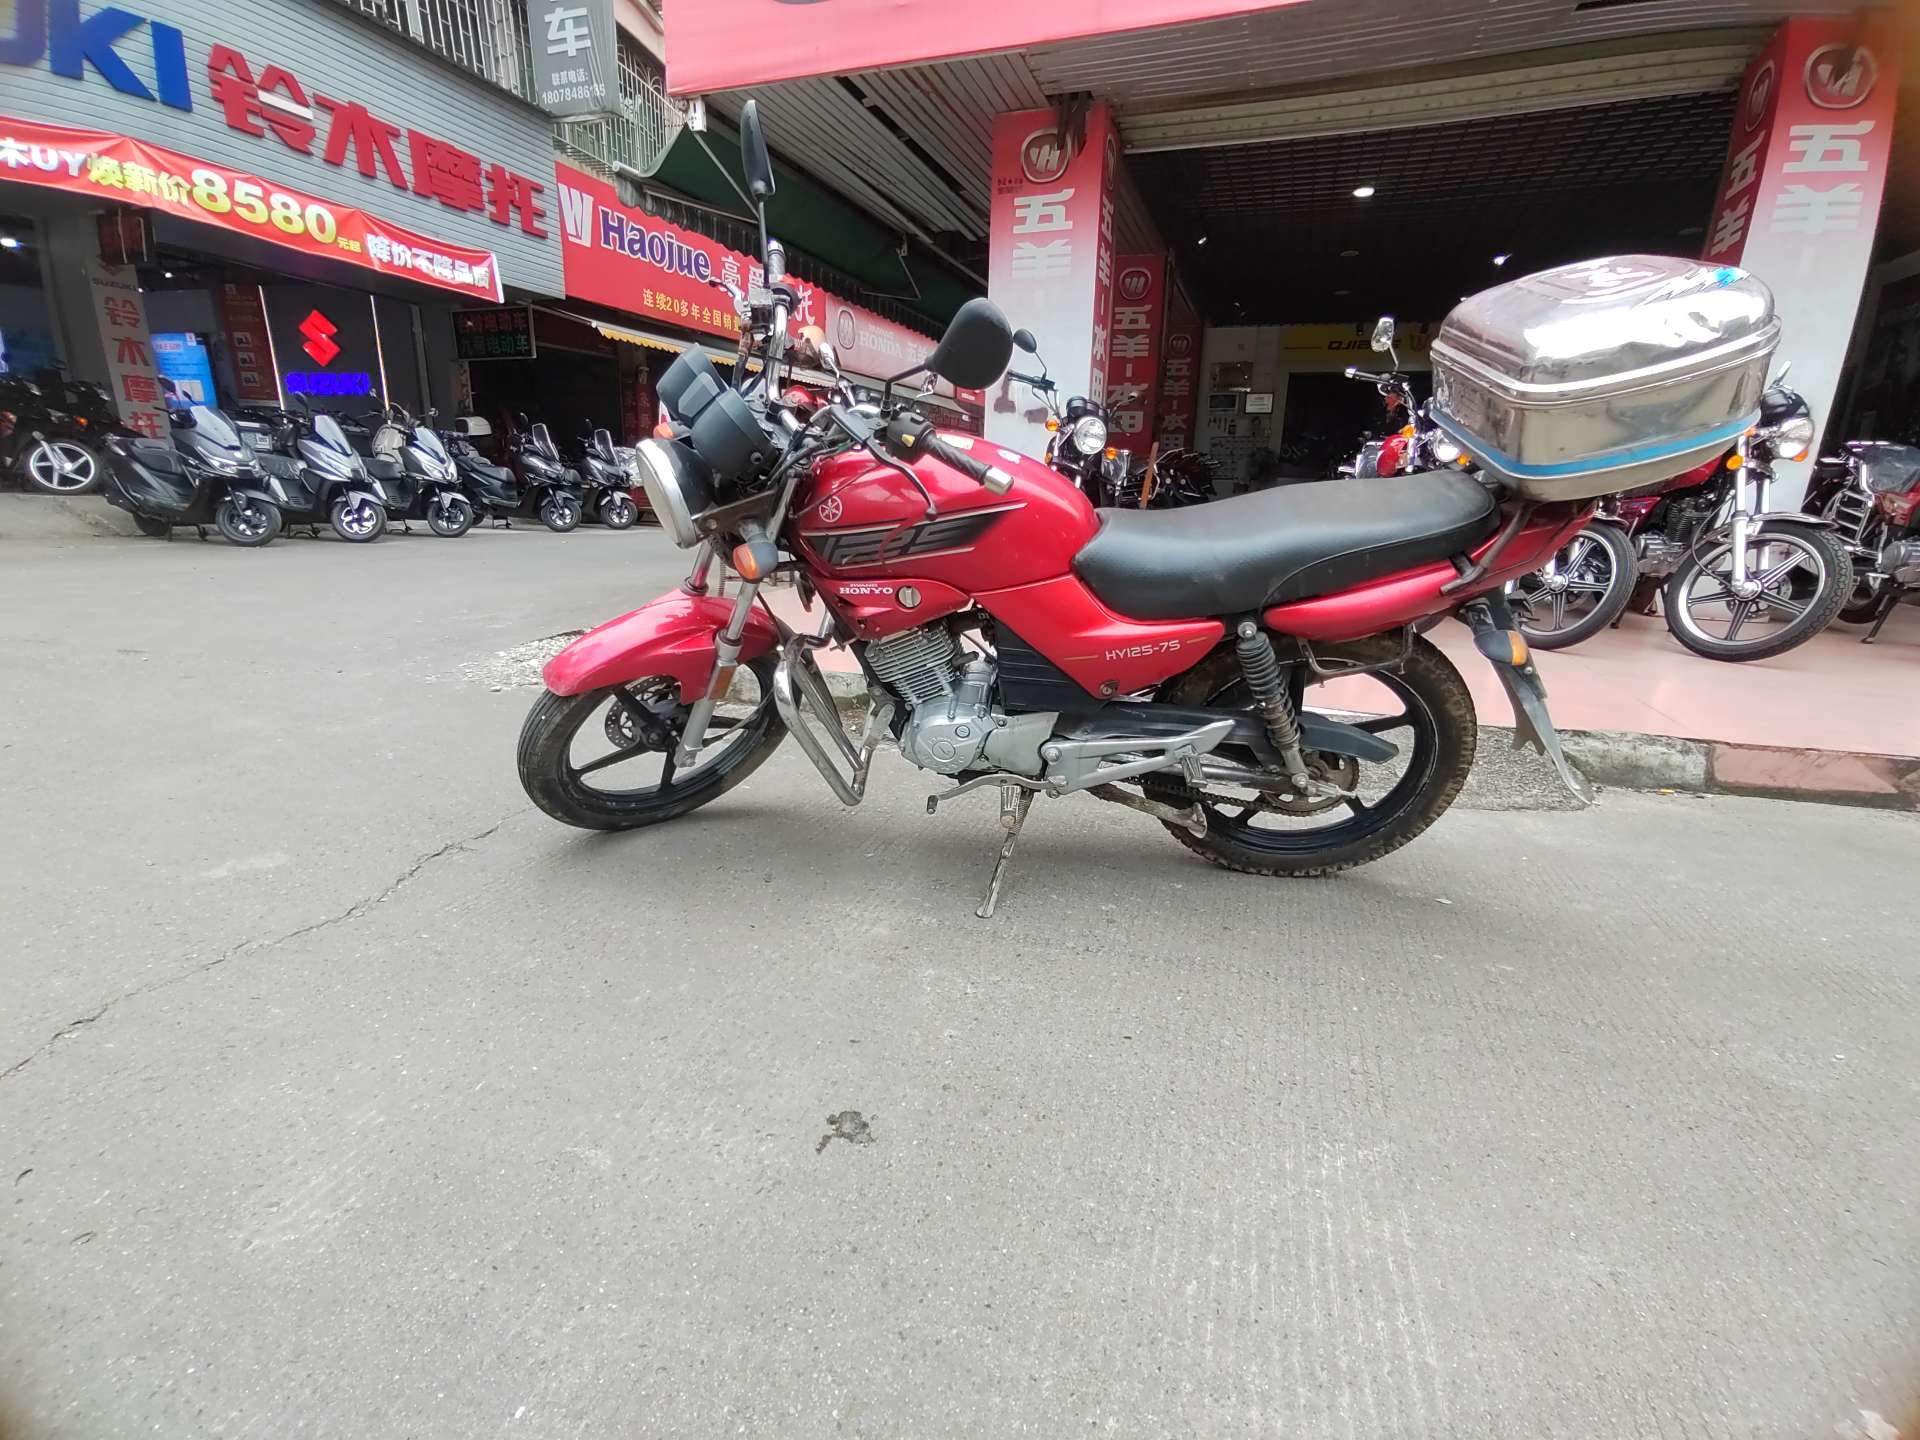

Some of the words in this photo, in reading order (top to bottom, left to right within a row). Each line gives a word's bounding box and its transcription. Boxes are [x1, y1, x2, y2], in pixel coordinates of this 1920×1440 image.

[544, 7, 591, 57] 车
[206, 43, 549, 239] 铃木摩托
[599, 206, 713, 284] Haojue
[839, 587, 893, 595] HONYO
